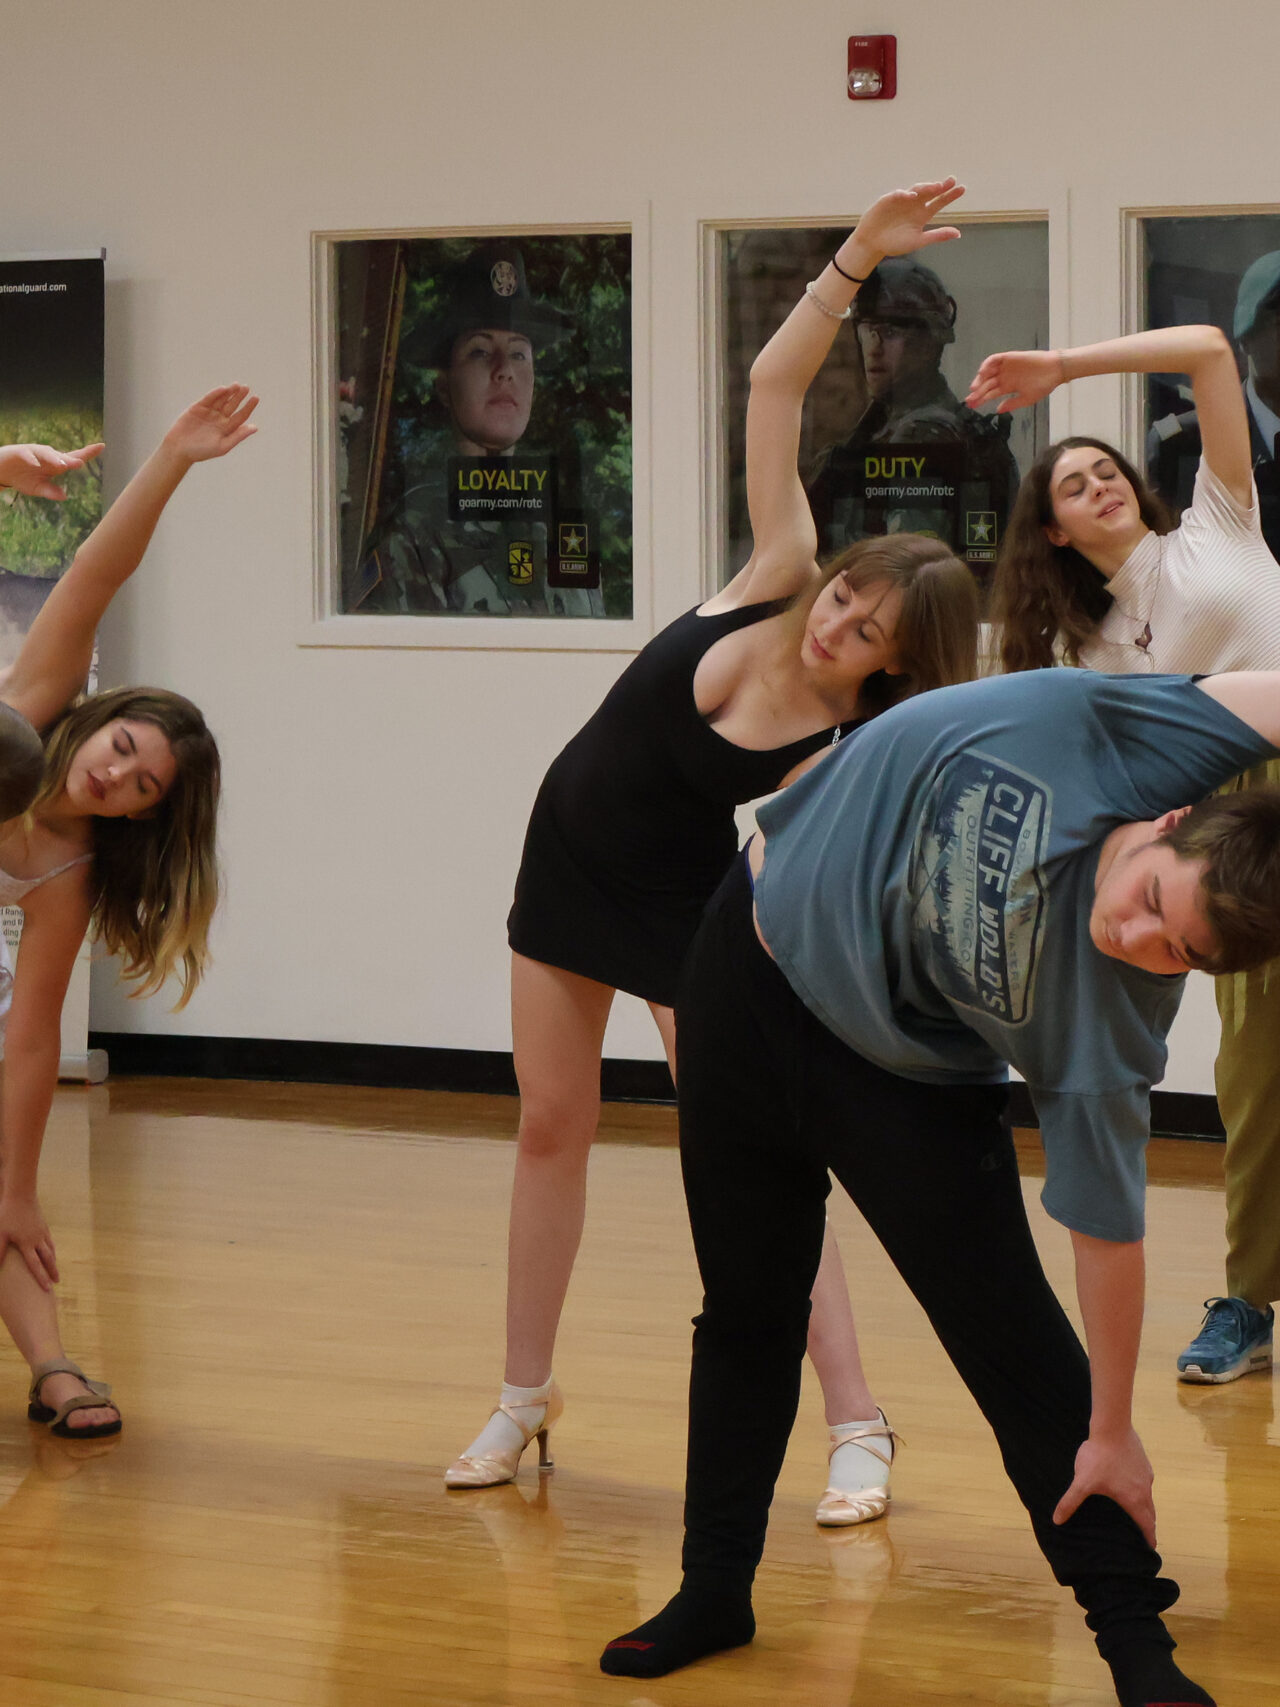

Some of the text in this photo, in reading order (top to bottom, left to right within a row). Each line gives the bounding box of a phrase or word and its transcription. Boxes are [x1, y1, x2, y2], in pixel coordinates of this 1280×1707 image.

[865, 457, 926, 478] DUTY
[458, 470, 547, 491] LOYALTY
[865, 485, 954, 499] goarmy.com/rotc
[459, 497, 542, 511] goarmy.com/rotc
[962, 815, 977, 931] OUTFITTING
[978, 782, 1025, 1013] CLIFF WOLD'S
